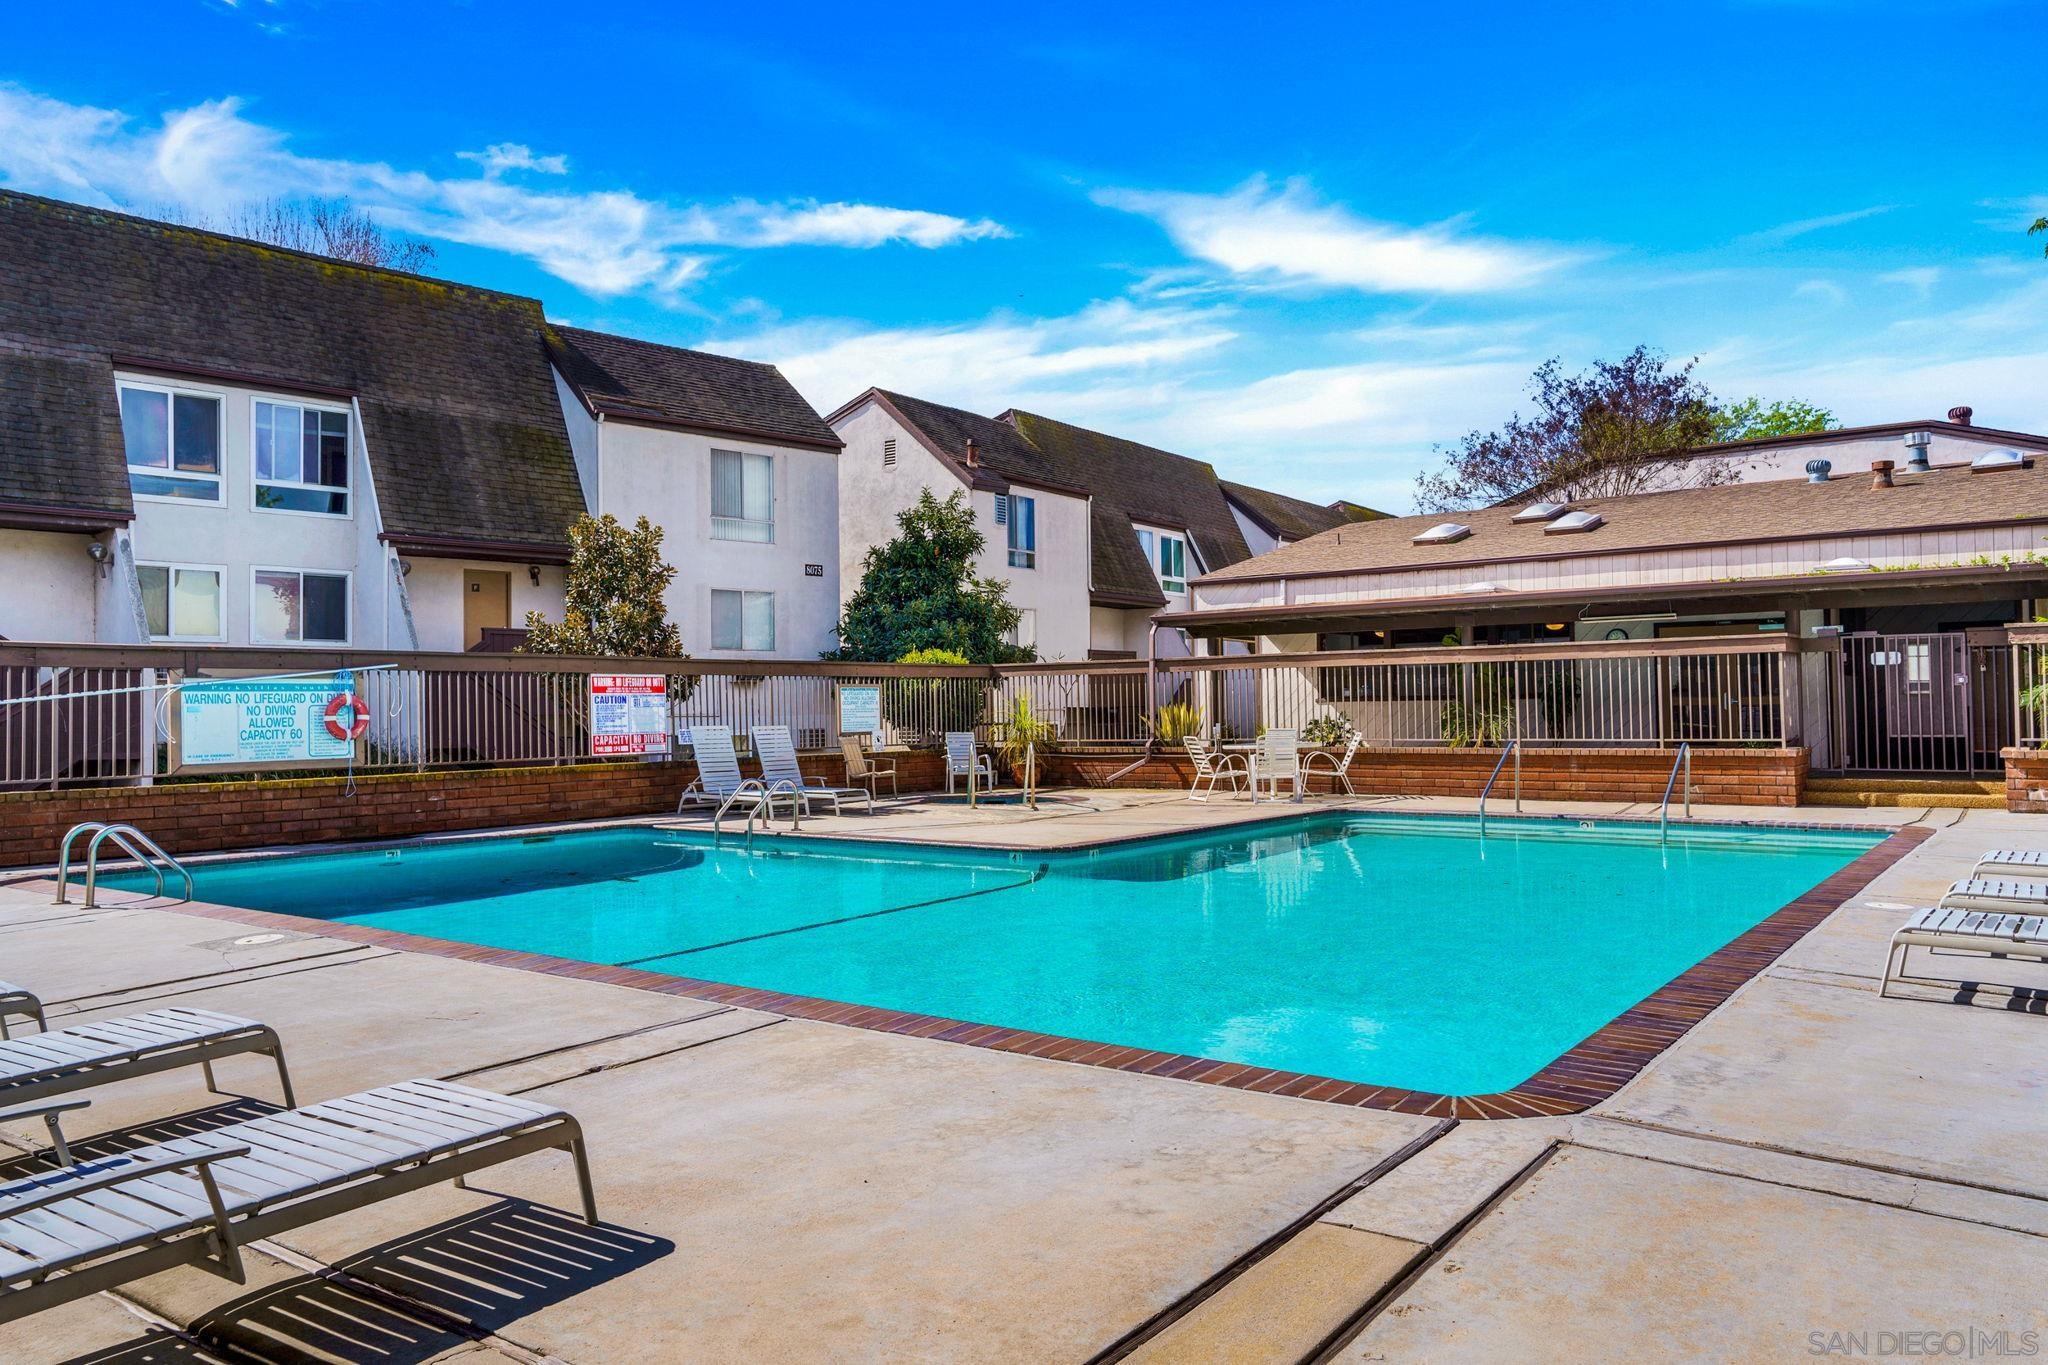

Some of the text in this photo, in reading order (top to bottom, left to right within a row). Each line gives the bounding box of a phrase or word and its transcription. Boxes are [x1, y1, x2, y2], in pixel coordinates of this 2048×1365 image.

[806, 565, 822, 576] 8075
[184, 693, 232, 704] WARNING
[235, 693, 250, 704] NO
[254, 693, 306, 704] LIFEGUARD
[310, 693, 323, 703] ON
[594, 695, 627, 704] CAUTION
[246, 705, 296, 716] NO DIVING
[249, 717, 295, 728] ALLOWED
[240, 728, 303, 741] CAPACITY 60
[594, 735, 629, 745] CAPACITY
[633, 733, 664, 743] NO DIVING
